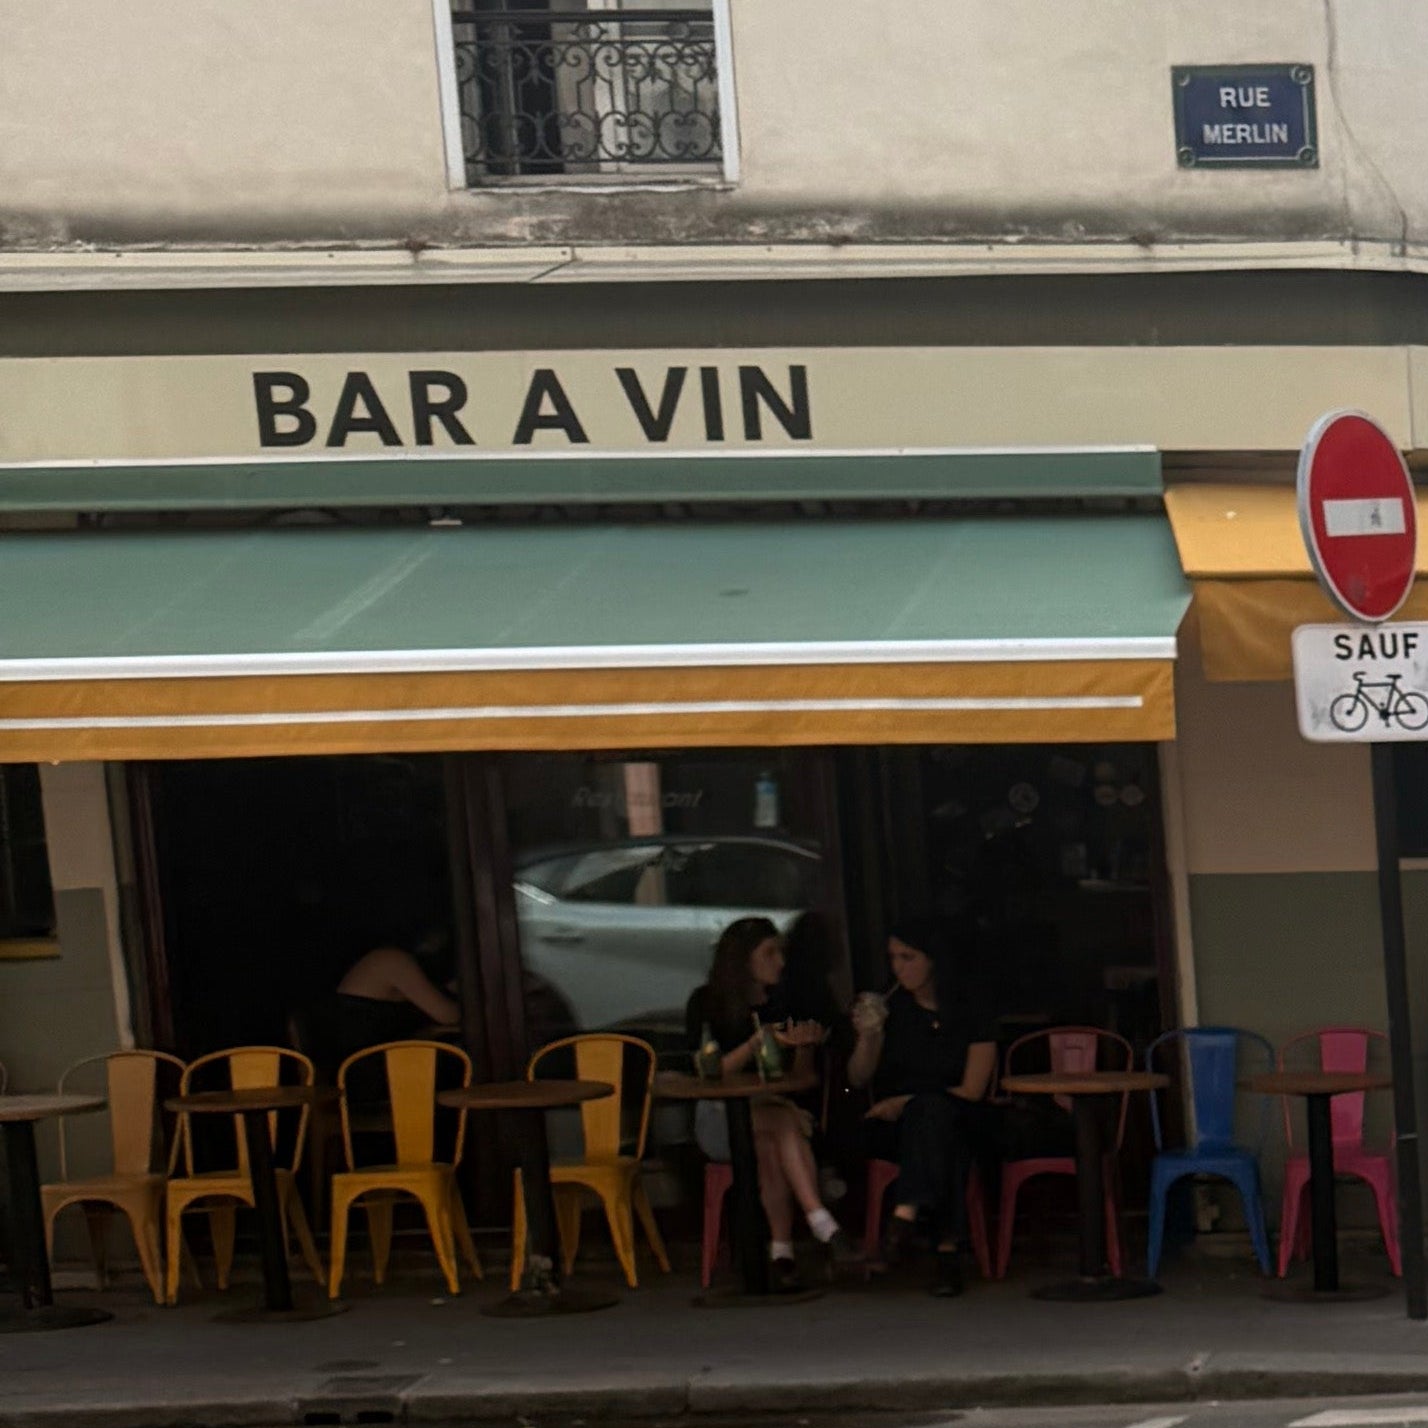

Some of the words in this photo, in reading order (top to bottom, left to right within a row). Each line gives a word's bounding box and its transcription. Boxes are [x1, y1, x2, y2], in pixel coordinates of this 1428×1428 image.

[1219, 86, 1272, 108] RUE
[1203, 123, 1288, 144] MERLIN
[252, 369, 476, 448] BAR
[512, 368, 590, 446] A
[614, 364, 813, 442] VIN
[1334, 632, 1419, 661] SAUF
